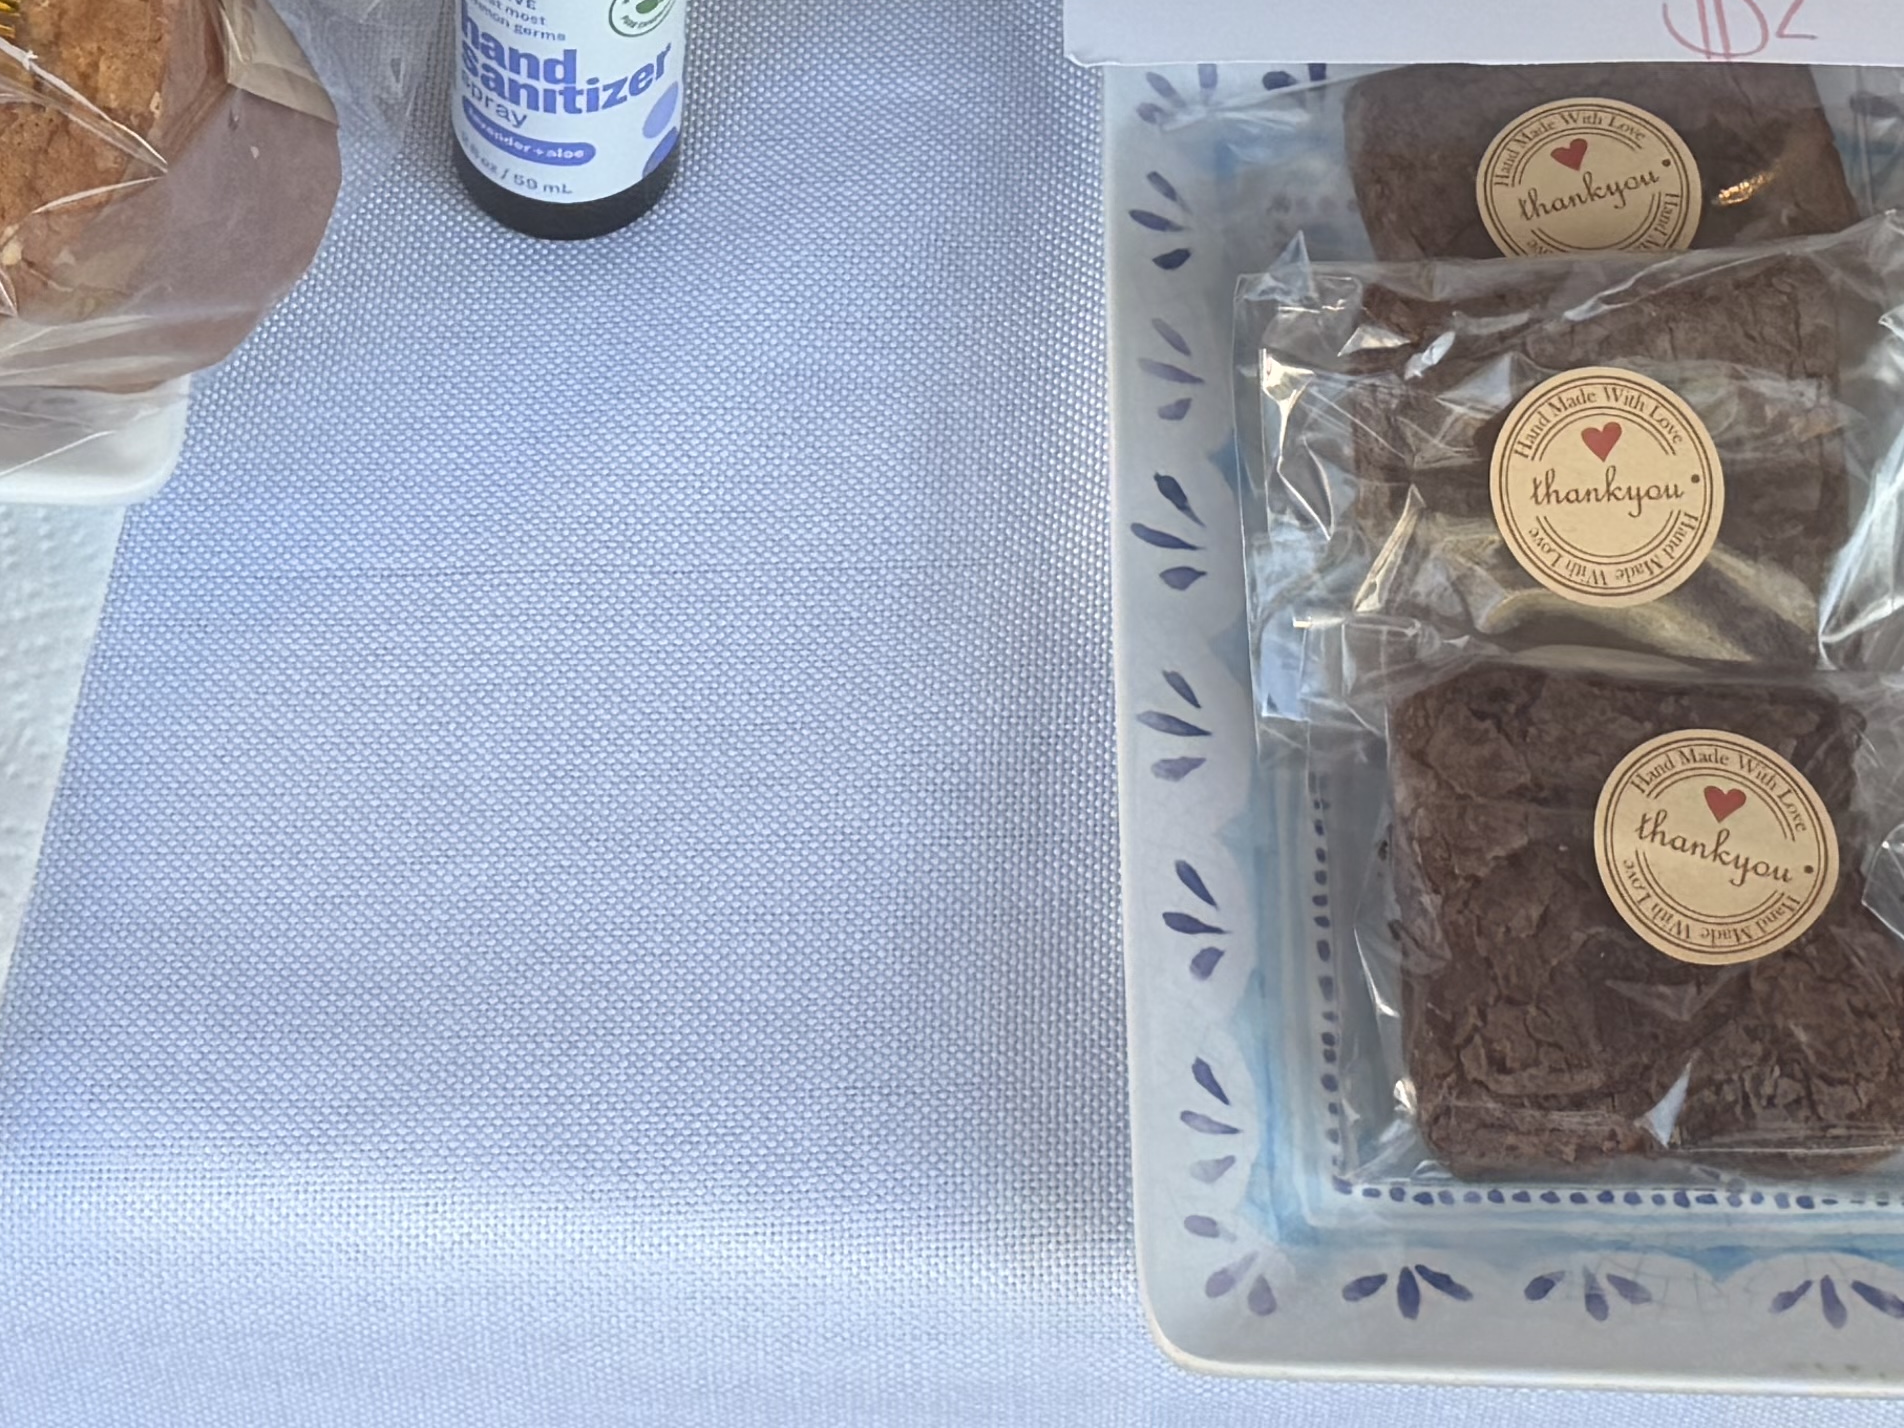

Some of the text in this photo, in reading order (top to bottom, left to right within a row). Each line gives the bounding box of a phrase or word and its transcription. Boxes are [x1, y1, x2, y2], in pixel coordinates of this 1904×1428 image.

[505, 6, 547, 26] most
[461, 41, 673, 115] sanitizer
[545, 147, 585, 159] aloe
[1493, 110, 1646, 188] Hand Made With Love
[542, 182, 573, 194] mL
[1517, 169, 1660, 221] thankyou
[1513, 386, 1684, 460] Hand Made With Love
[1530, 464, 1685, 519] thankyou
[1629, 747, 1808, 834] Hand Made With Love
[1634, 808, 1794, 888] thankyou
